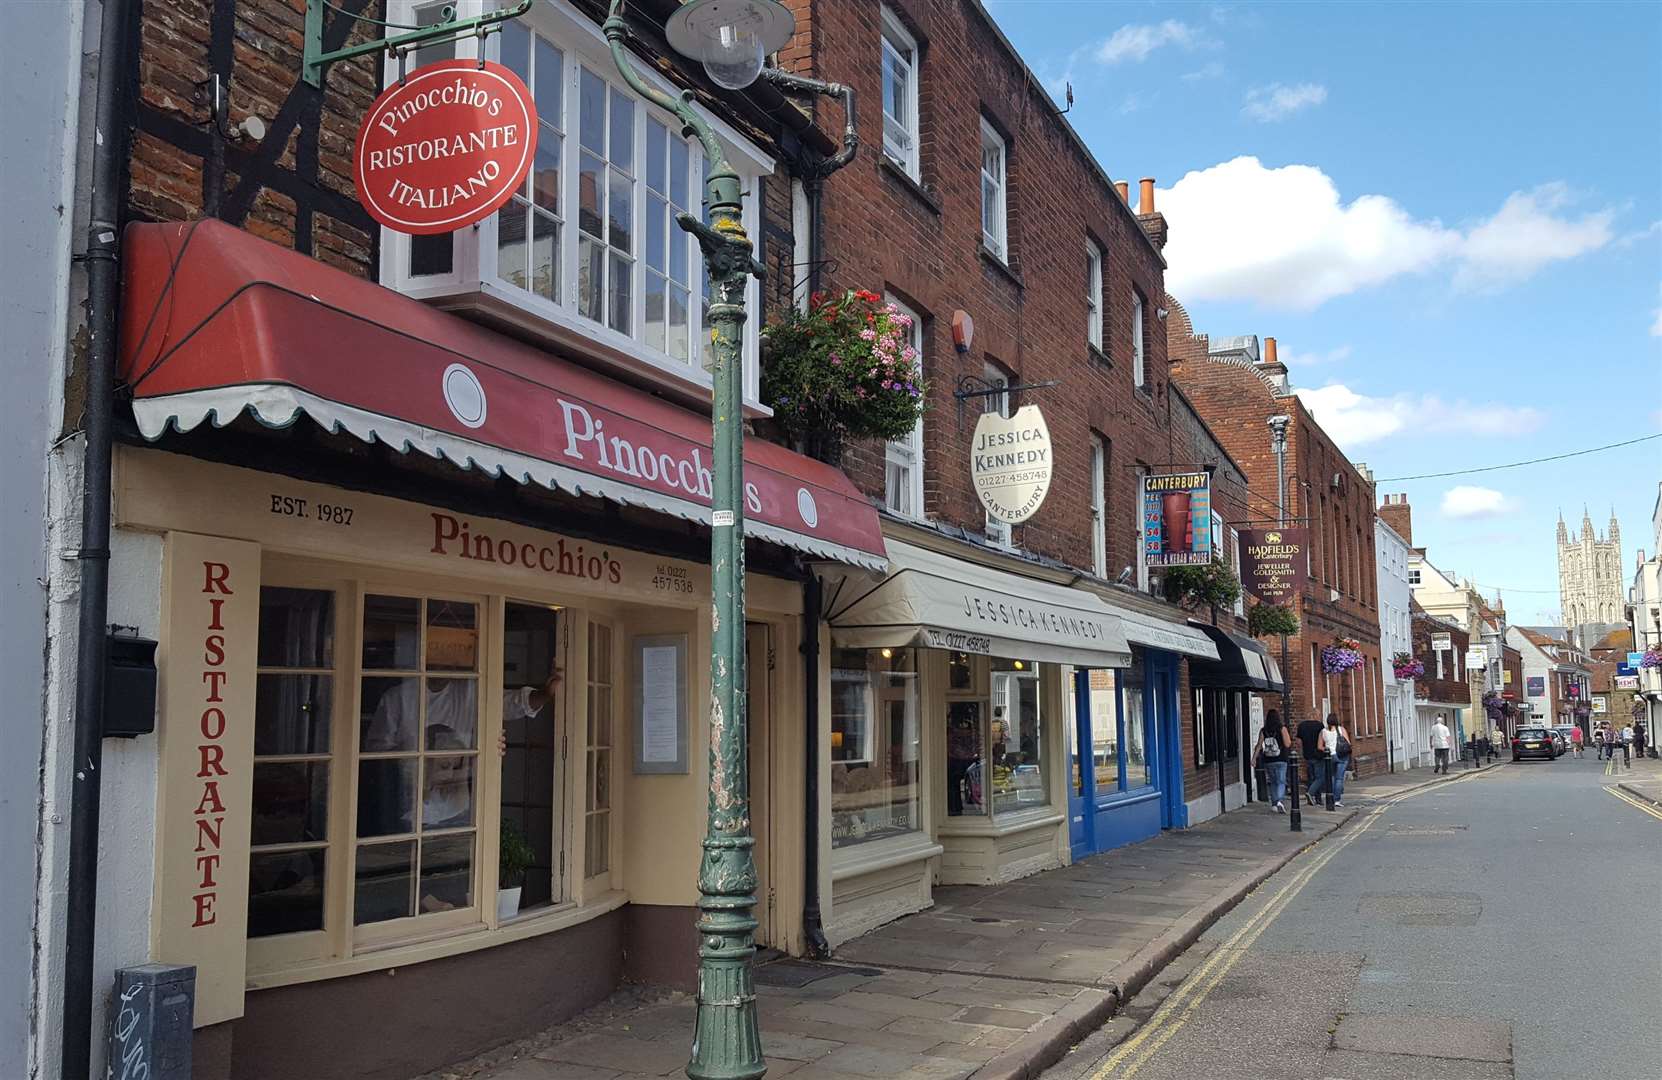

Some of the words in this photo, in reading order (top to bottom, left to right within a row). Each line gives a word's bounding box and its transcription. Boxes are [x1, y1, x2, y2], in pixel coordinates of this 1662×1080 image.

[370, 124, 518, 171] RISTORANTE
[388, 160, 500, 209] ITALIANO
[977, 428, 1043, 451] JESSICA
[975, 448, 1047, 473] KENNEDY
[1146, 475, 1206, 491] CANTERBURY
[271, 494, 309, 518] EST.
[317, 504, 354, 526] 1987
[983, 485, 1043, 519] CANTERBURY
[431, 512, 621, 584] Pinocchio's
[1248, 544, 1300, 557] HADFIELD'S
[964, 594, 1039, 630] JESSICA
[1039, 611, 1105, 641] KENNEDY
[191, 561, 234, 928] RISTORANTE
